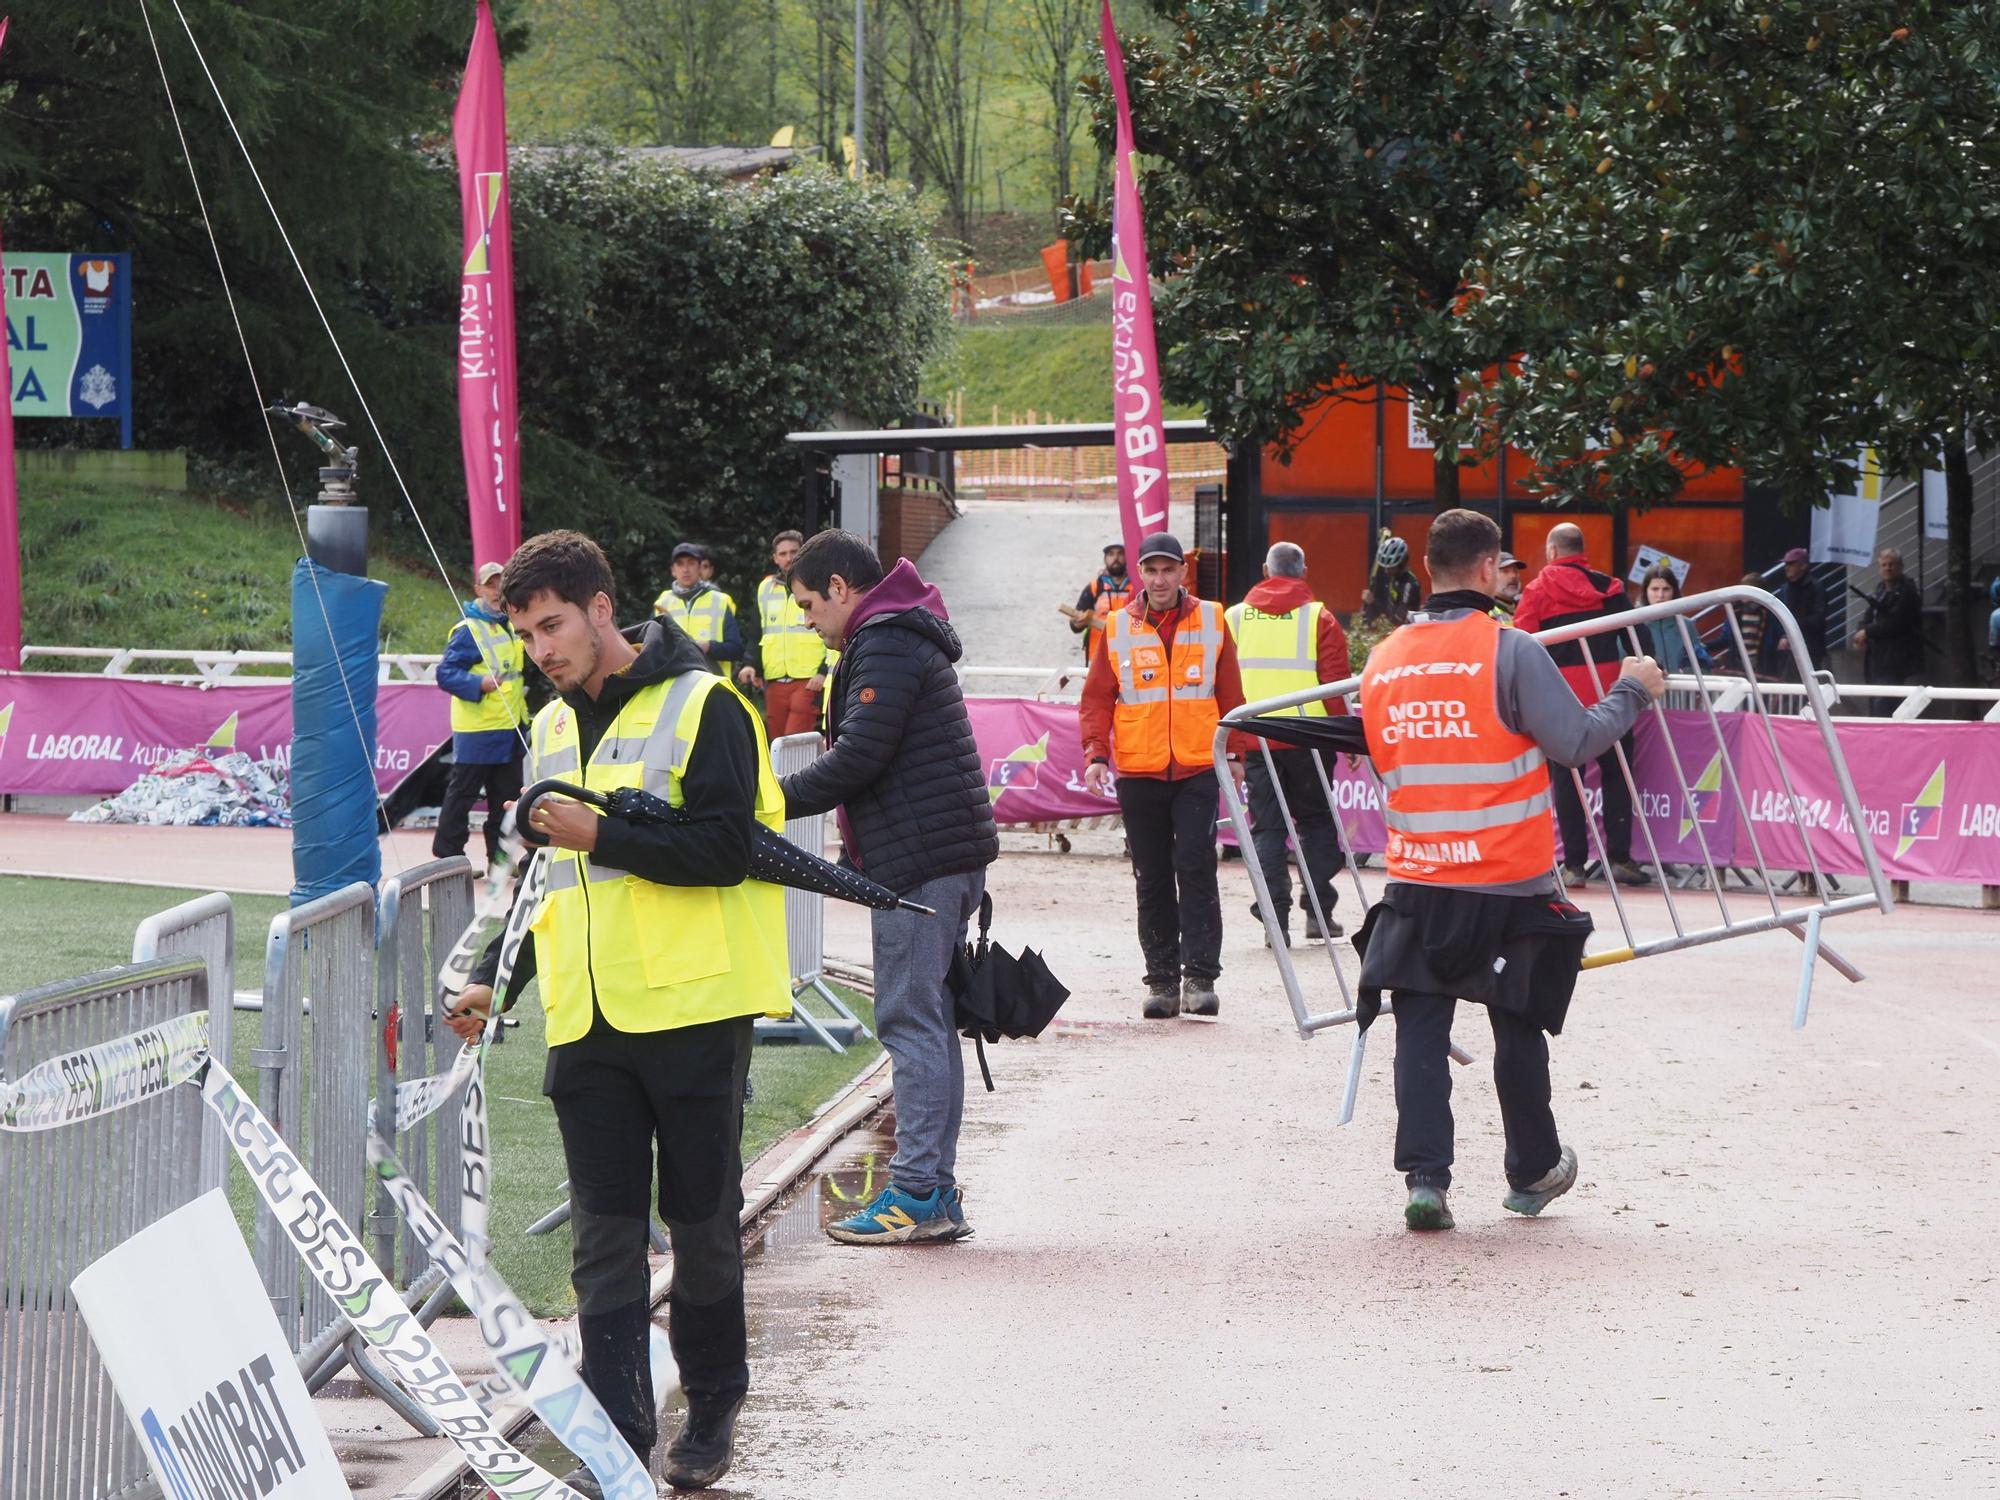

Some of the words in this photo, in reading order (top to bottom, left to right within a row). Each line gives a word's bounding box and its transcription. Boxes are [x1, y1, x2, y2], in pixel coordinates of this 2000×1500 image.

[2, 268, 54, 298] TA
[1371, 661, 1483, 686] NIKEN
[1387, 700, 1466, 723] MOTO
[1380, 720, 1479, 745] OFICIAL
[26, 734, 123, 761] LABORAL
[377, 748, 410, 770] txa
[1835, 803, 1890, 836] ktxa
[1401, 840, 1482, 864] YAMAHA
[167, 1352, 307, 1500] DANOBAT
